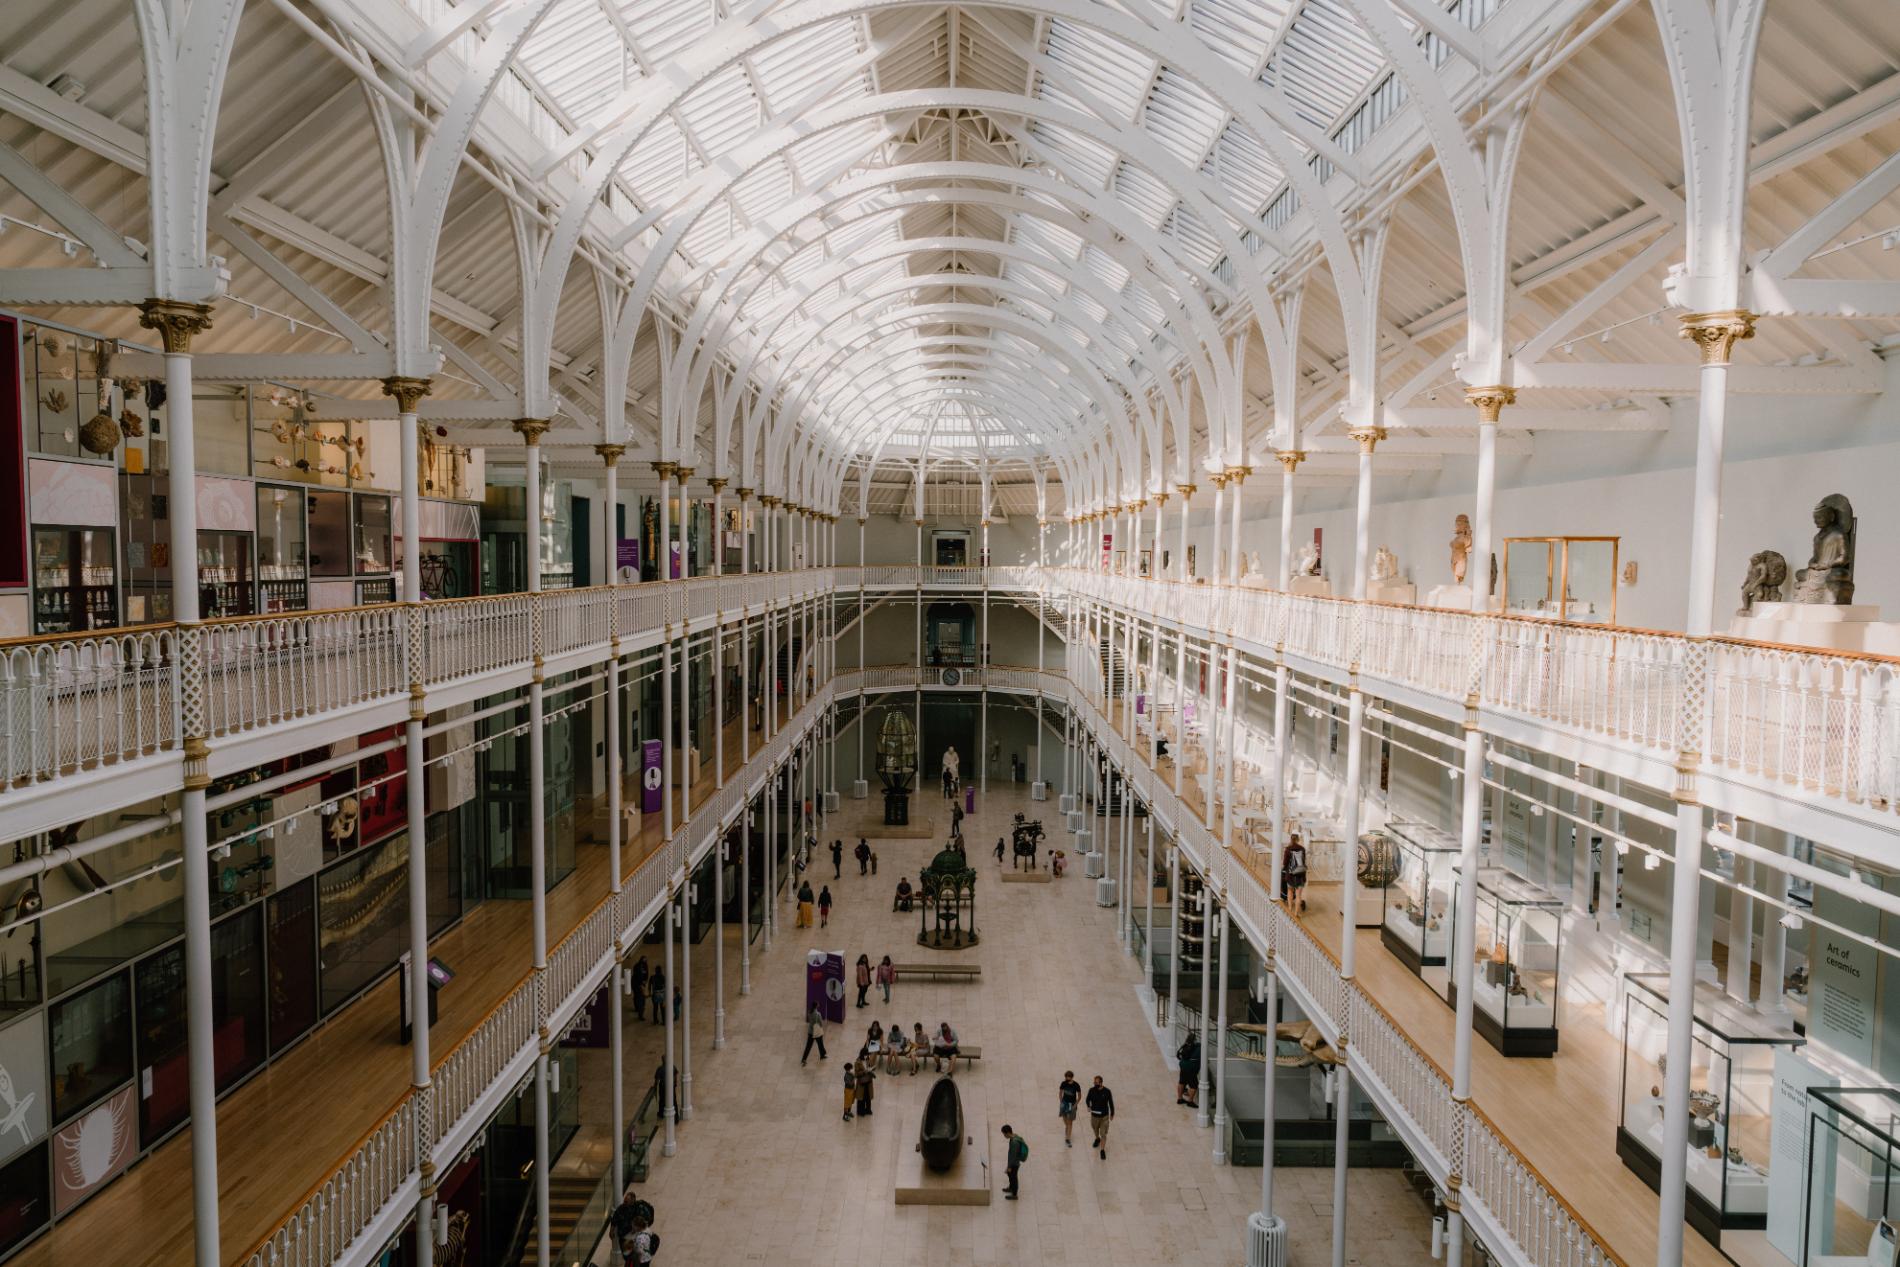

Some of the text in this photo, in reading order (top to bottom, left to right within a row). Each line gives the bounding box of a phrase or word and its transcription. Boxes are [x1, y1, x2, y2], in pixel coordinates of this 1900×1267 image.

[1827, 942, 1850, 959] Art of
[1826, 956, 1860, 978] ceramics
